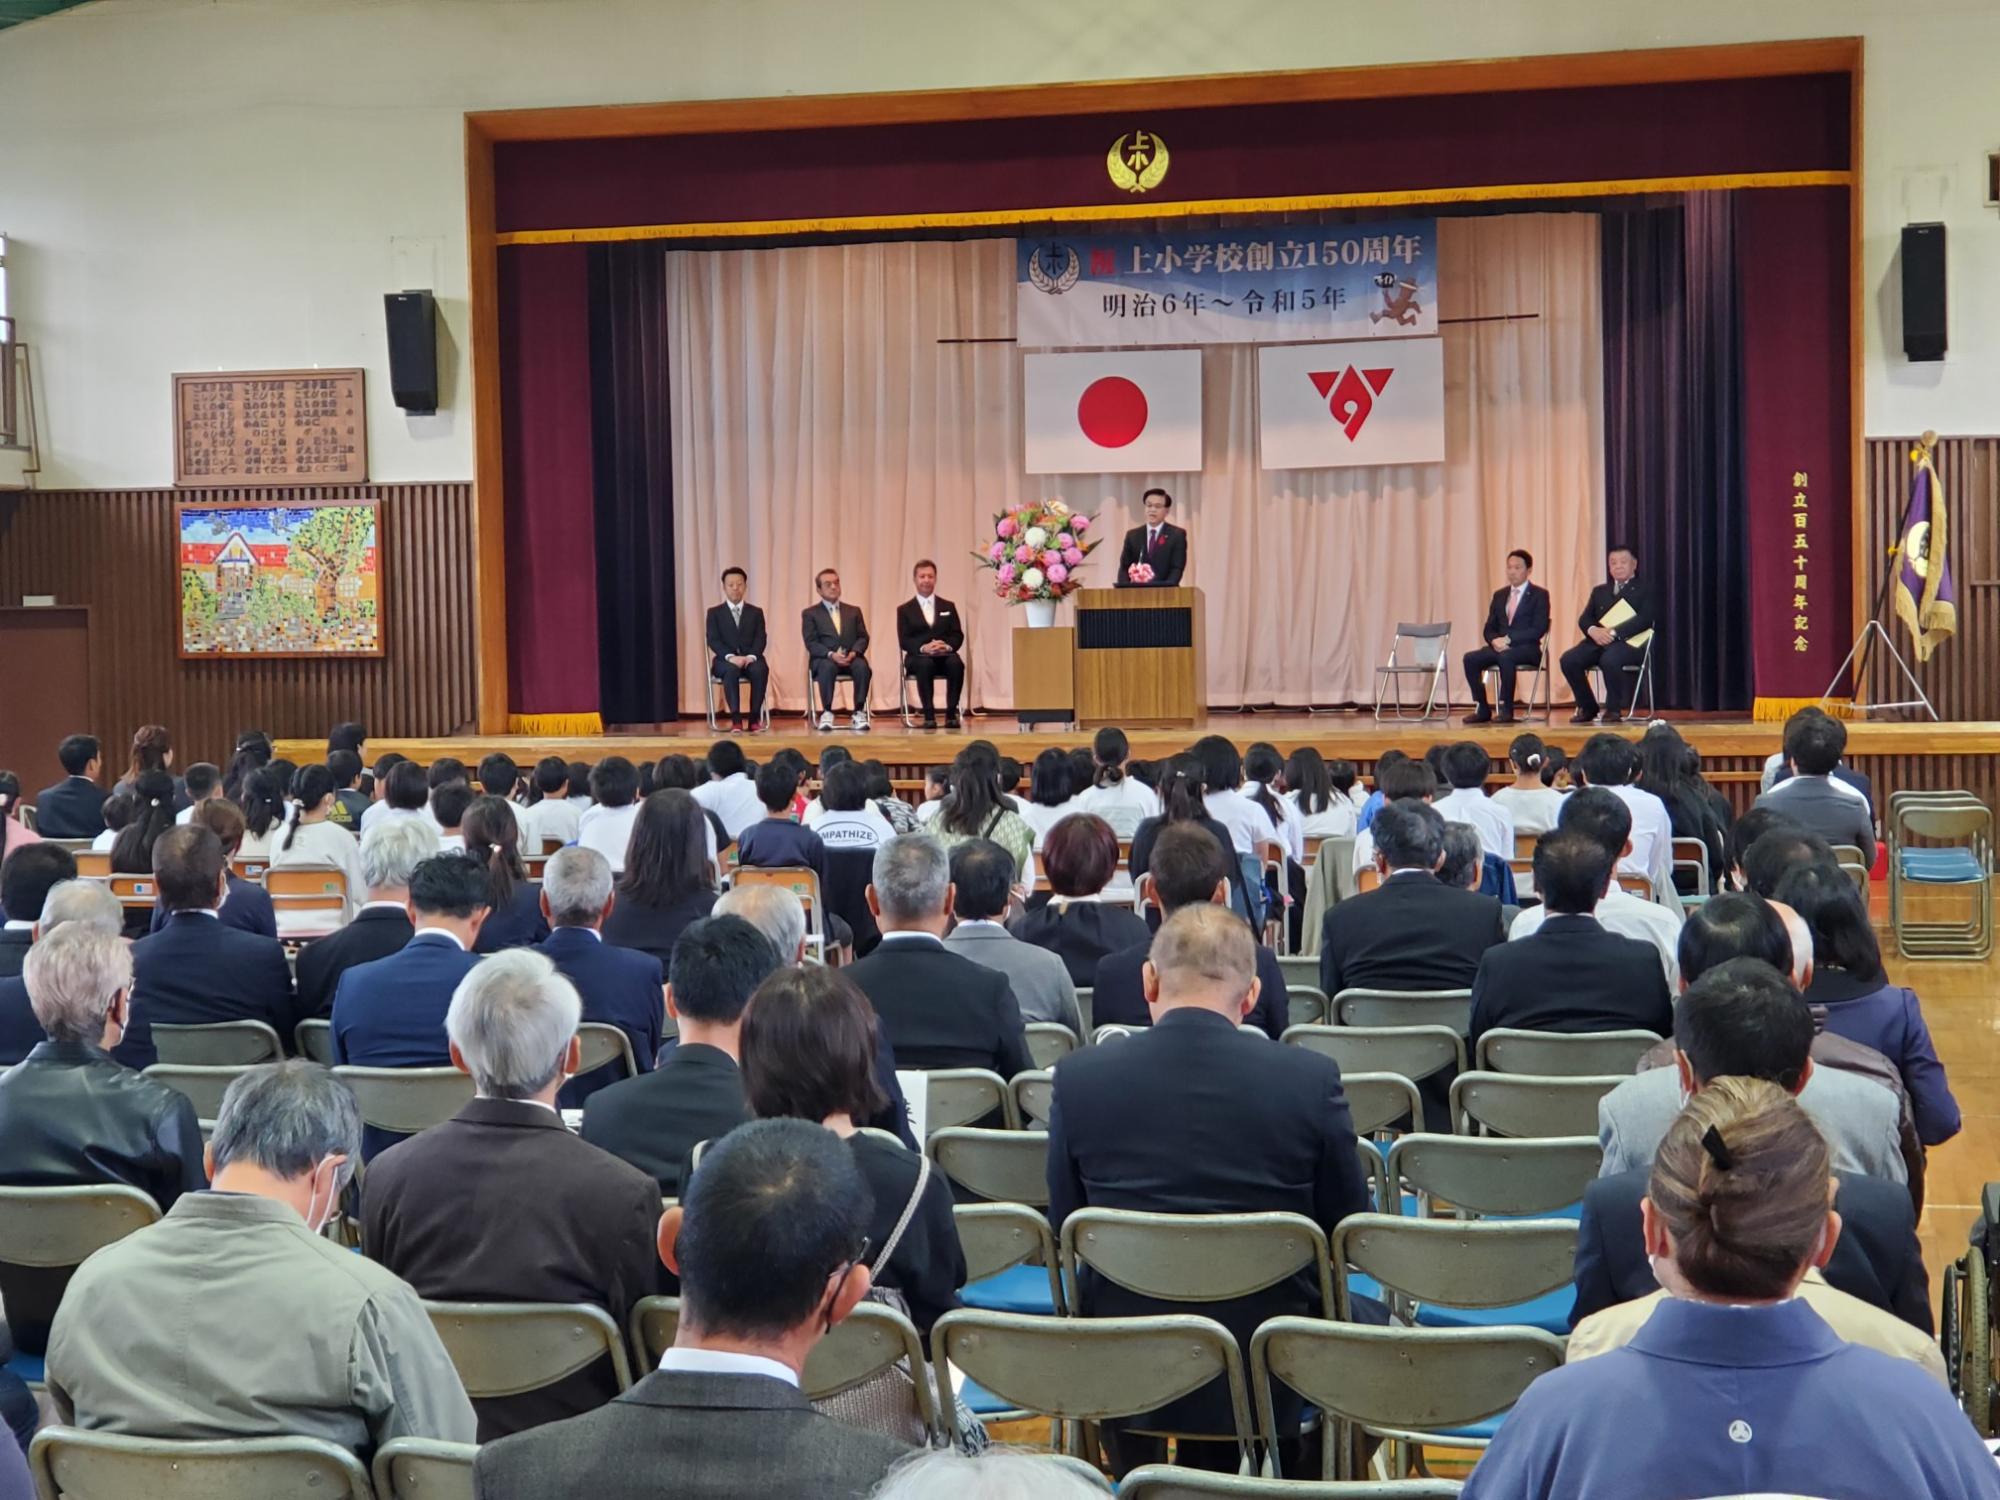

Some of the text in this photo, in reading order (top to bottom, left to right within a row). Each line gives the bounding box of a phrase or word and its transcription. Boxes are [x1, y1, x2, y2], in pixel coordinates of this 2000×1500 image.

[1124, 234, 1422, 274] 上小学校創立150周年
[1792, 471, 1809, 652] 創立百五十周年記念
[821, 829, 873, 841] MPATHIZE
